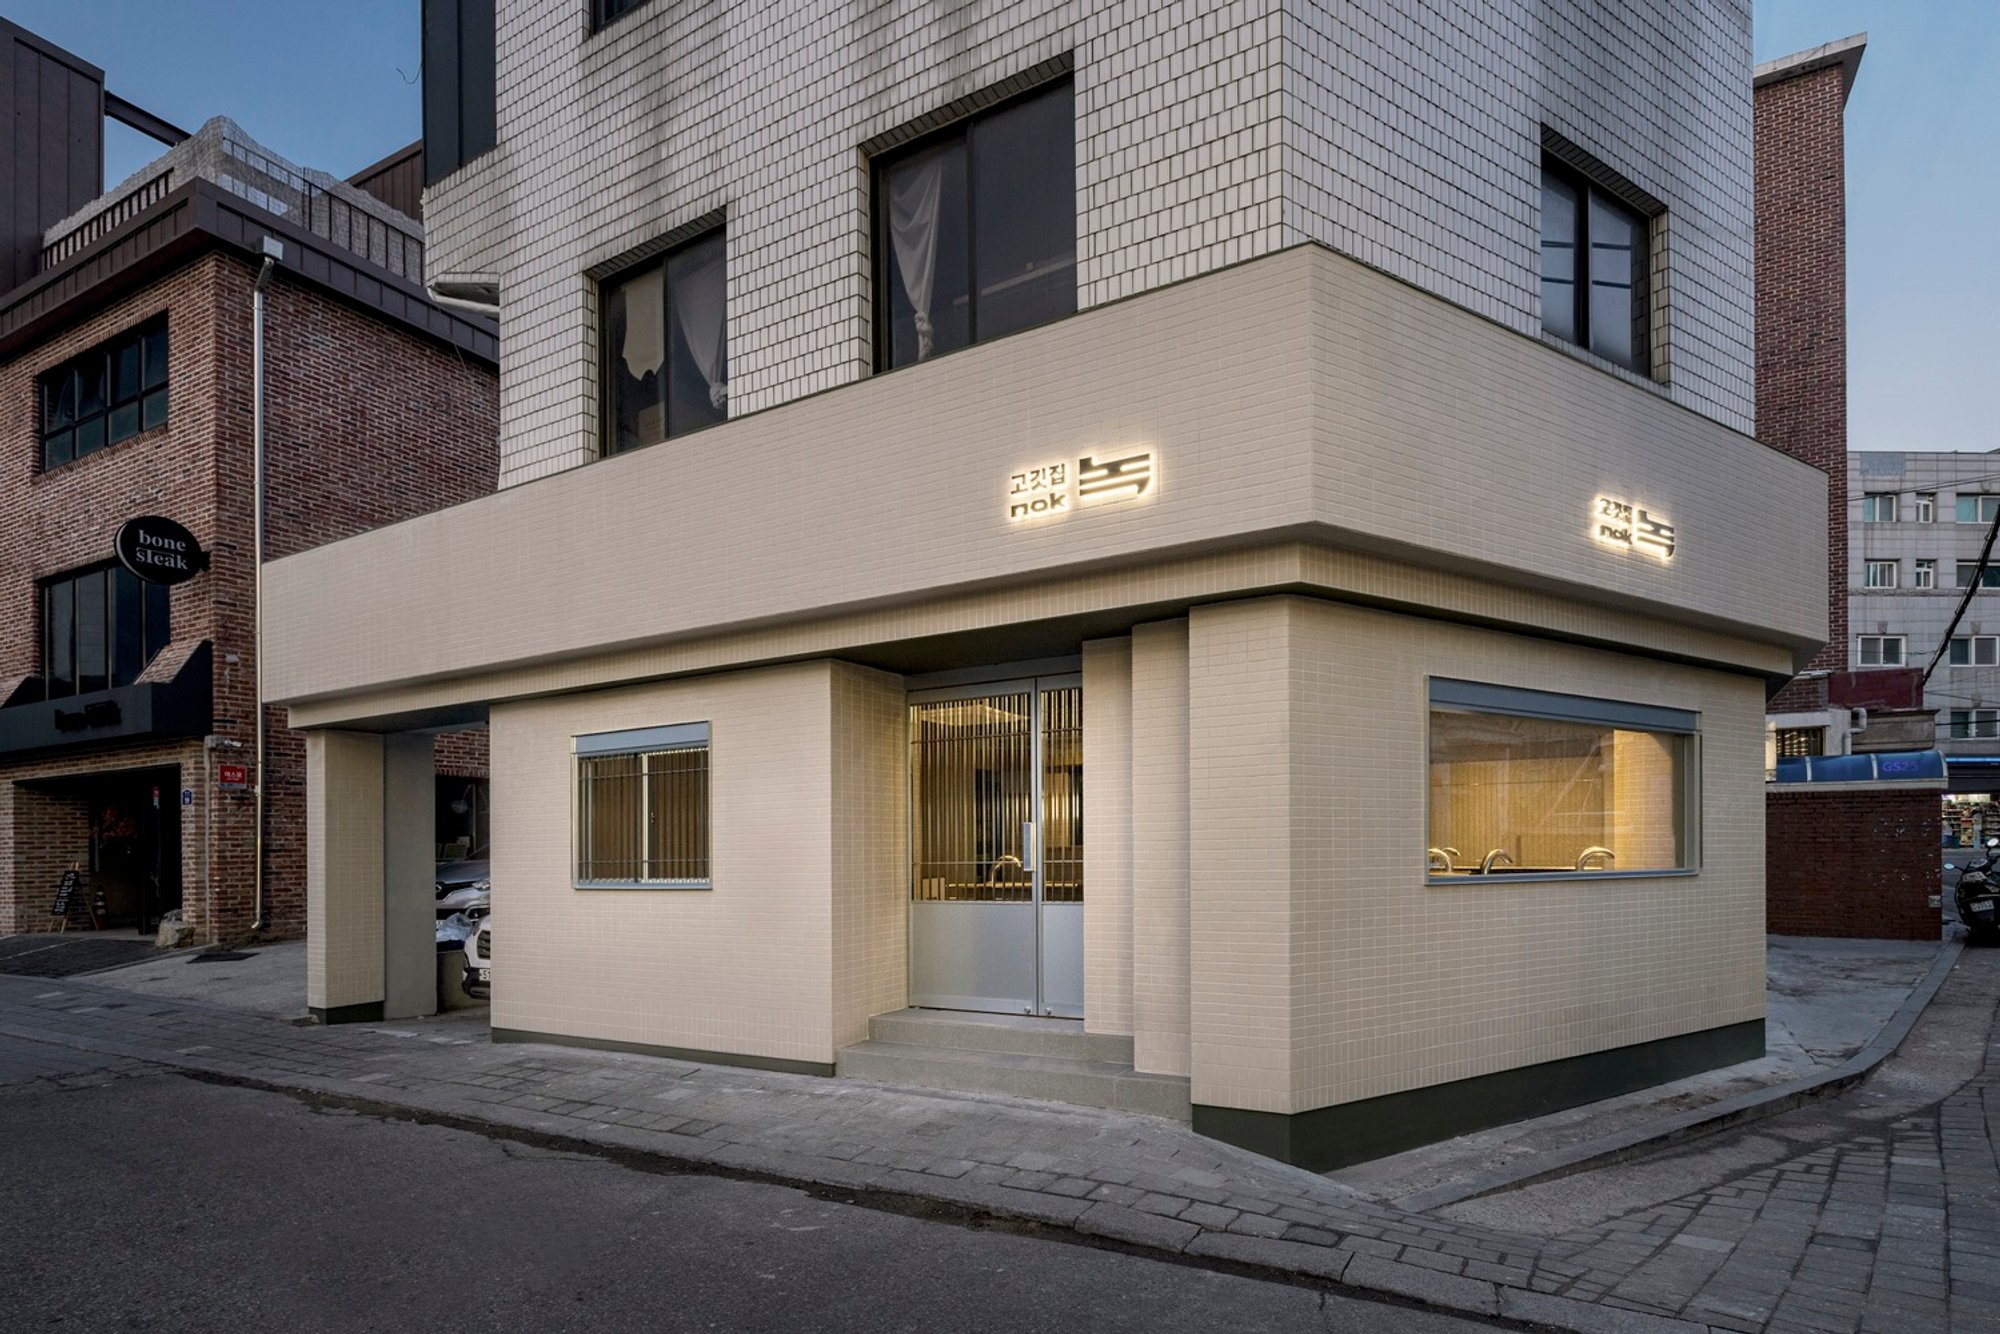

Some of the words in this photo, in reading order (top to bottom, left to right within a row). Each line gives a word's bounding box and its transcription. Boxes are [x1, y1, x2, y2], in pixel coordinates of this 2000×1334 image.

[1010, 463, 1066, 495] 고깃집
[1010, 492, 1066, 518] nok
[138, 529, 187, 551] bone
[1599, 525, 1633, 546] nok
[1882, 761, 1919, 772] GS25
